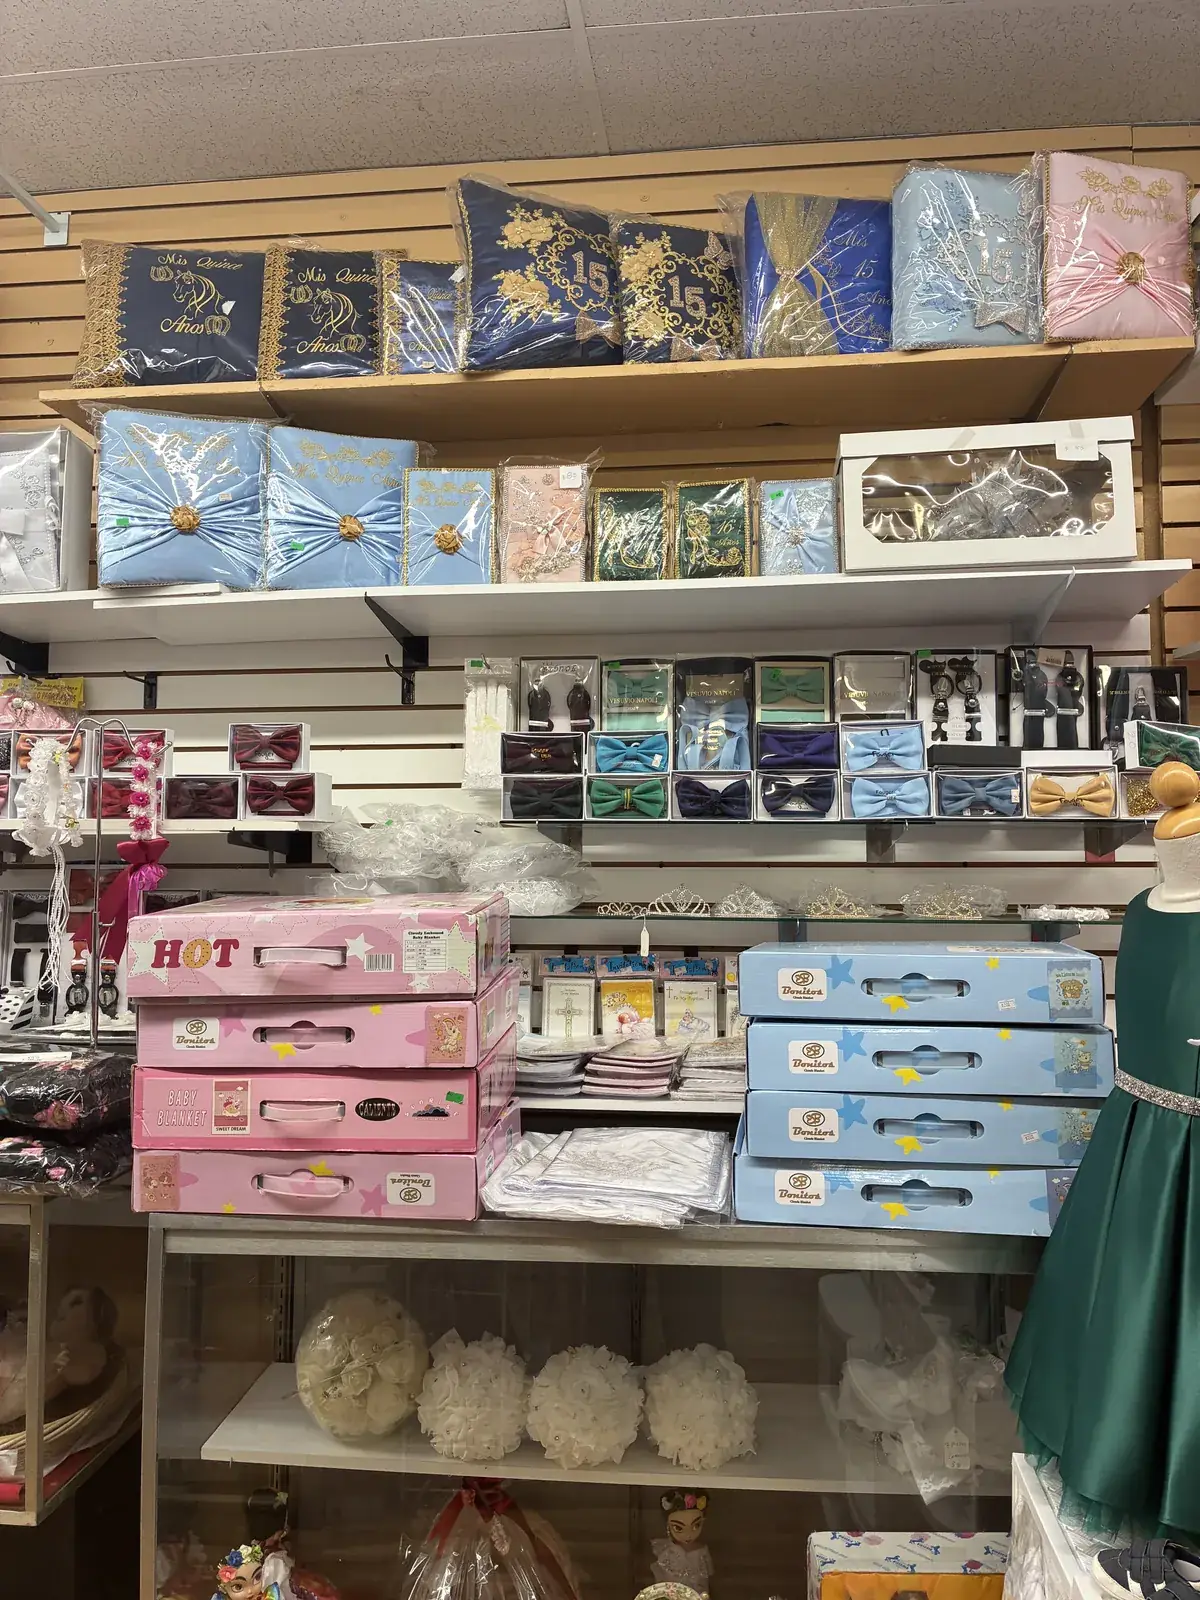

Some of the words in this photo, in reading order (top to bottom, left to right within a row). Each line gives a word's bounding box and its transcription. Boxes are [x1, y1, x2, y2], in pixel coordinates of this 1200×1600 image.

[833, 230, 869, 248] Mis
[157, 253, 187, 265] Mis
[196, 257, 243, 270] Quince
[975, 233, 1015, 284] 15
[298, 266, 326, 284] Mis
[572, 251, 609, 298] 15
[853, 258, 879, 279] 15
[667, 275, 707, 321] 15
[160, 314, 205, 335] Años
[296, 335, 341, 354] Años
[716, 520, 735, 535] 16
[151, 938, 239, 969] HOT
[782, 986, 824, 995] Bonitos
[176, 1036, 216, 1044] Bonitos
[792, 1058, 835, 1068] Bonitos
[168, 1090, 197, 1107] BABY
[358, 1102, 397, 1117] CALIENTE
[157, 1110, 208, 1127] BLANKET
[792, 1127, 835, 1136] Bonitos
[390, 1178, 431, 1187] Bonitos
[779, 1189, 822, 1199] Bonitos
